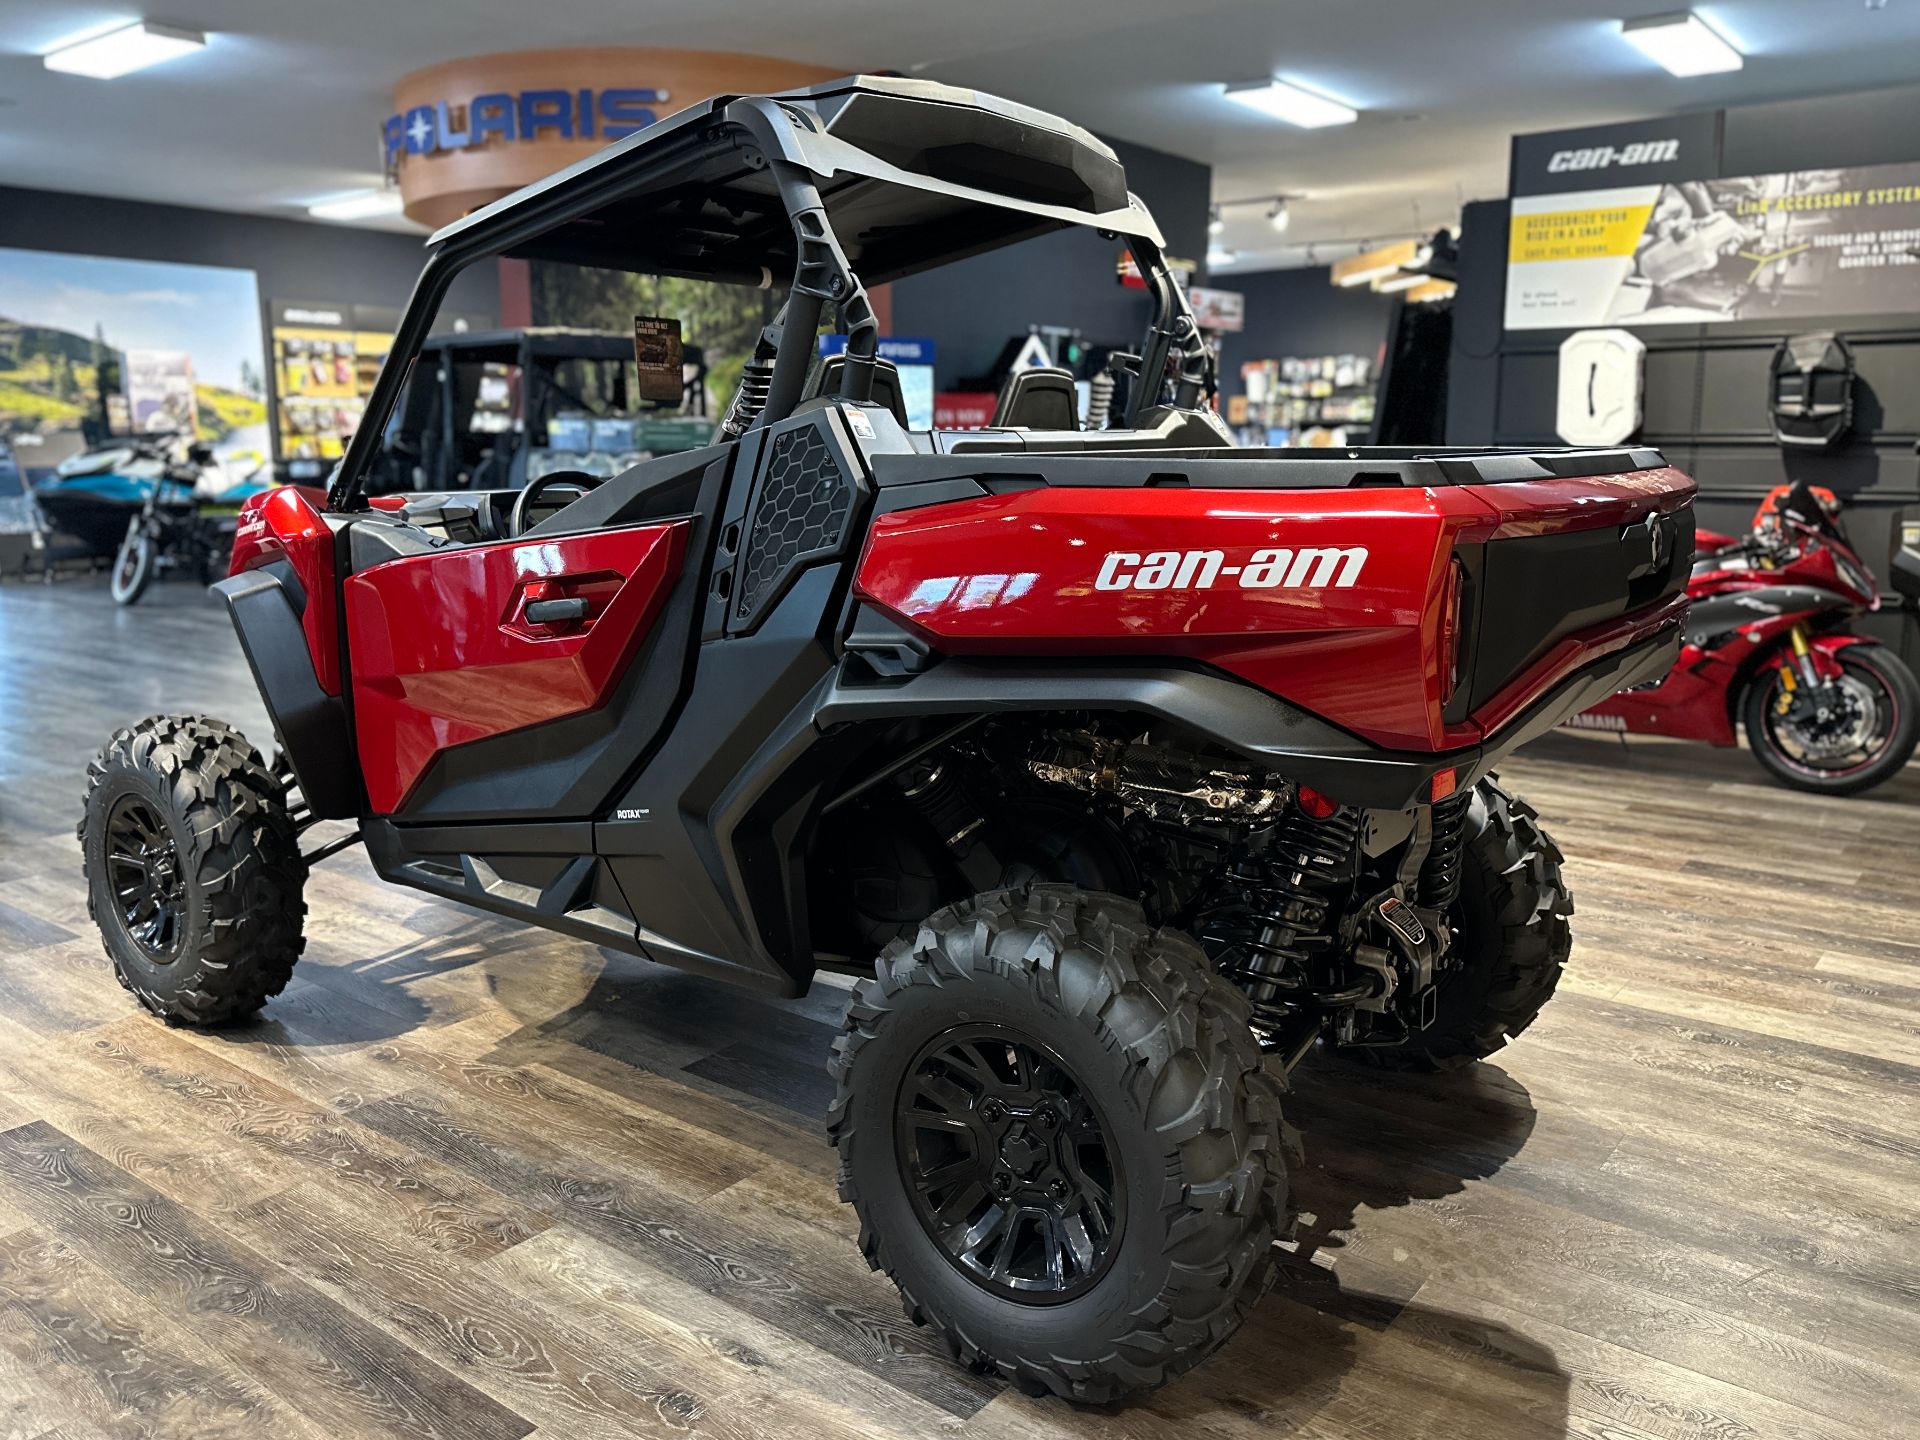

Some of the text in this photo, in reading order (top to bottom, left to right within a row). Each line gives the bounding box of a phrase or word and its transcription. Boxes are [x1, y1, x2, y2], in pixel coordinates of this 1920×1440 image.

[385, 88, 659, 164] POLARIS
[1547, 138, 1679, 173] can-am
[1776, 192, 1862, 212] ACCESSORY
[1601, 211, 1628, 223] YOUR
[1526, 227, 1605, 241] RIDE IN A SNAP
[1814, 234, 1852, 247] SECURE
[1855, 232, 1877, 244] AND
[1872, 243, 1880, 254] A
[1839, 255, 1885, 269] QUARTER
[1094, 546, 1369, 591] can-am
[617, 809, 640, 819] ROTAX
